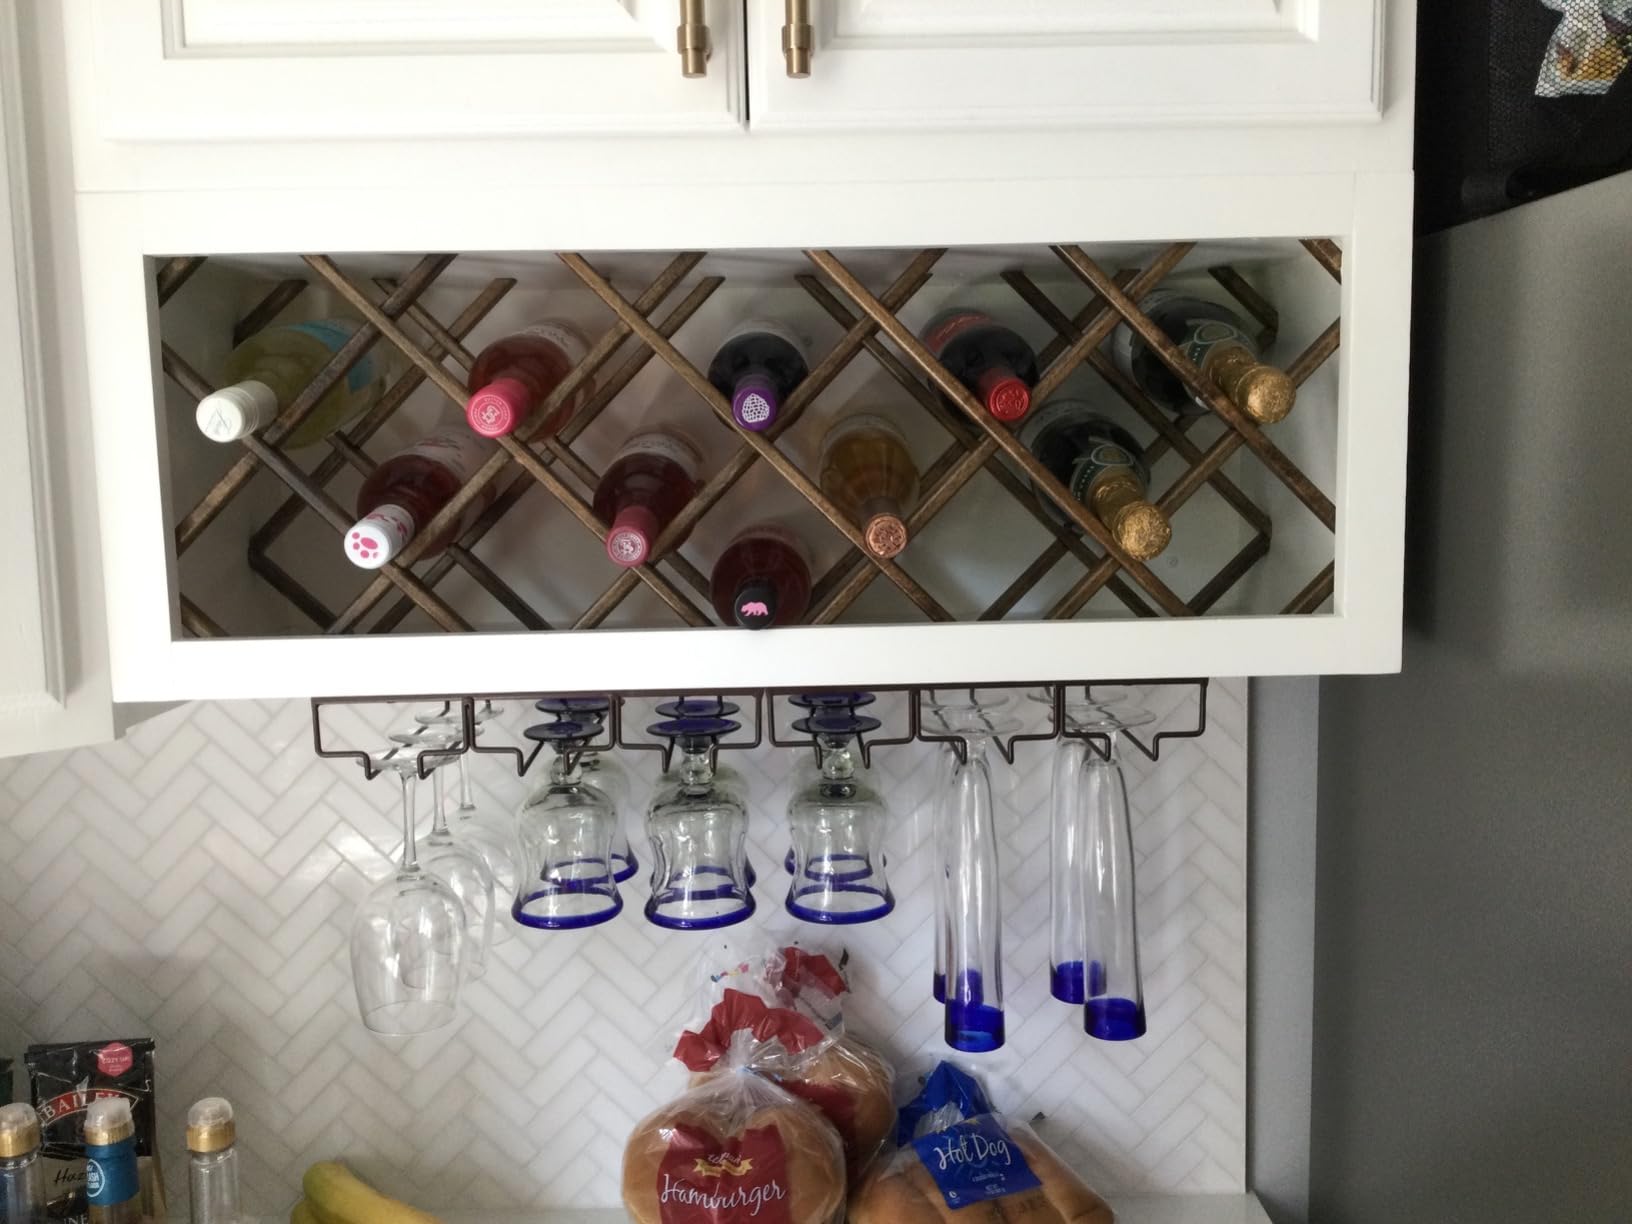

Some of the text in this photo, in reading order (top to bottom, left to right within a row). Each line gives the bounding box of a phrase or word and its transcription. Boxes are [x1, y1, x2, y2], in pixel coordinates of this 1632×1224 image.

[934, 1133, 1012, 1170] Hot Dog
[661, 1174, 786, 1217] Hamburger
